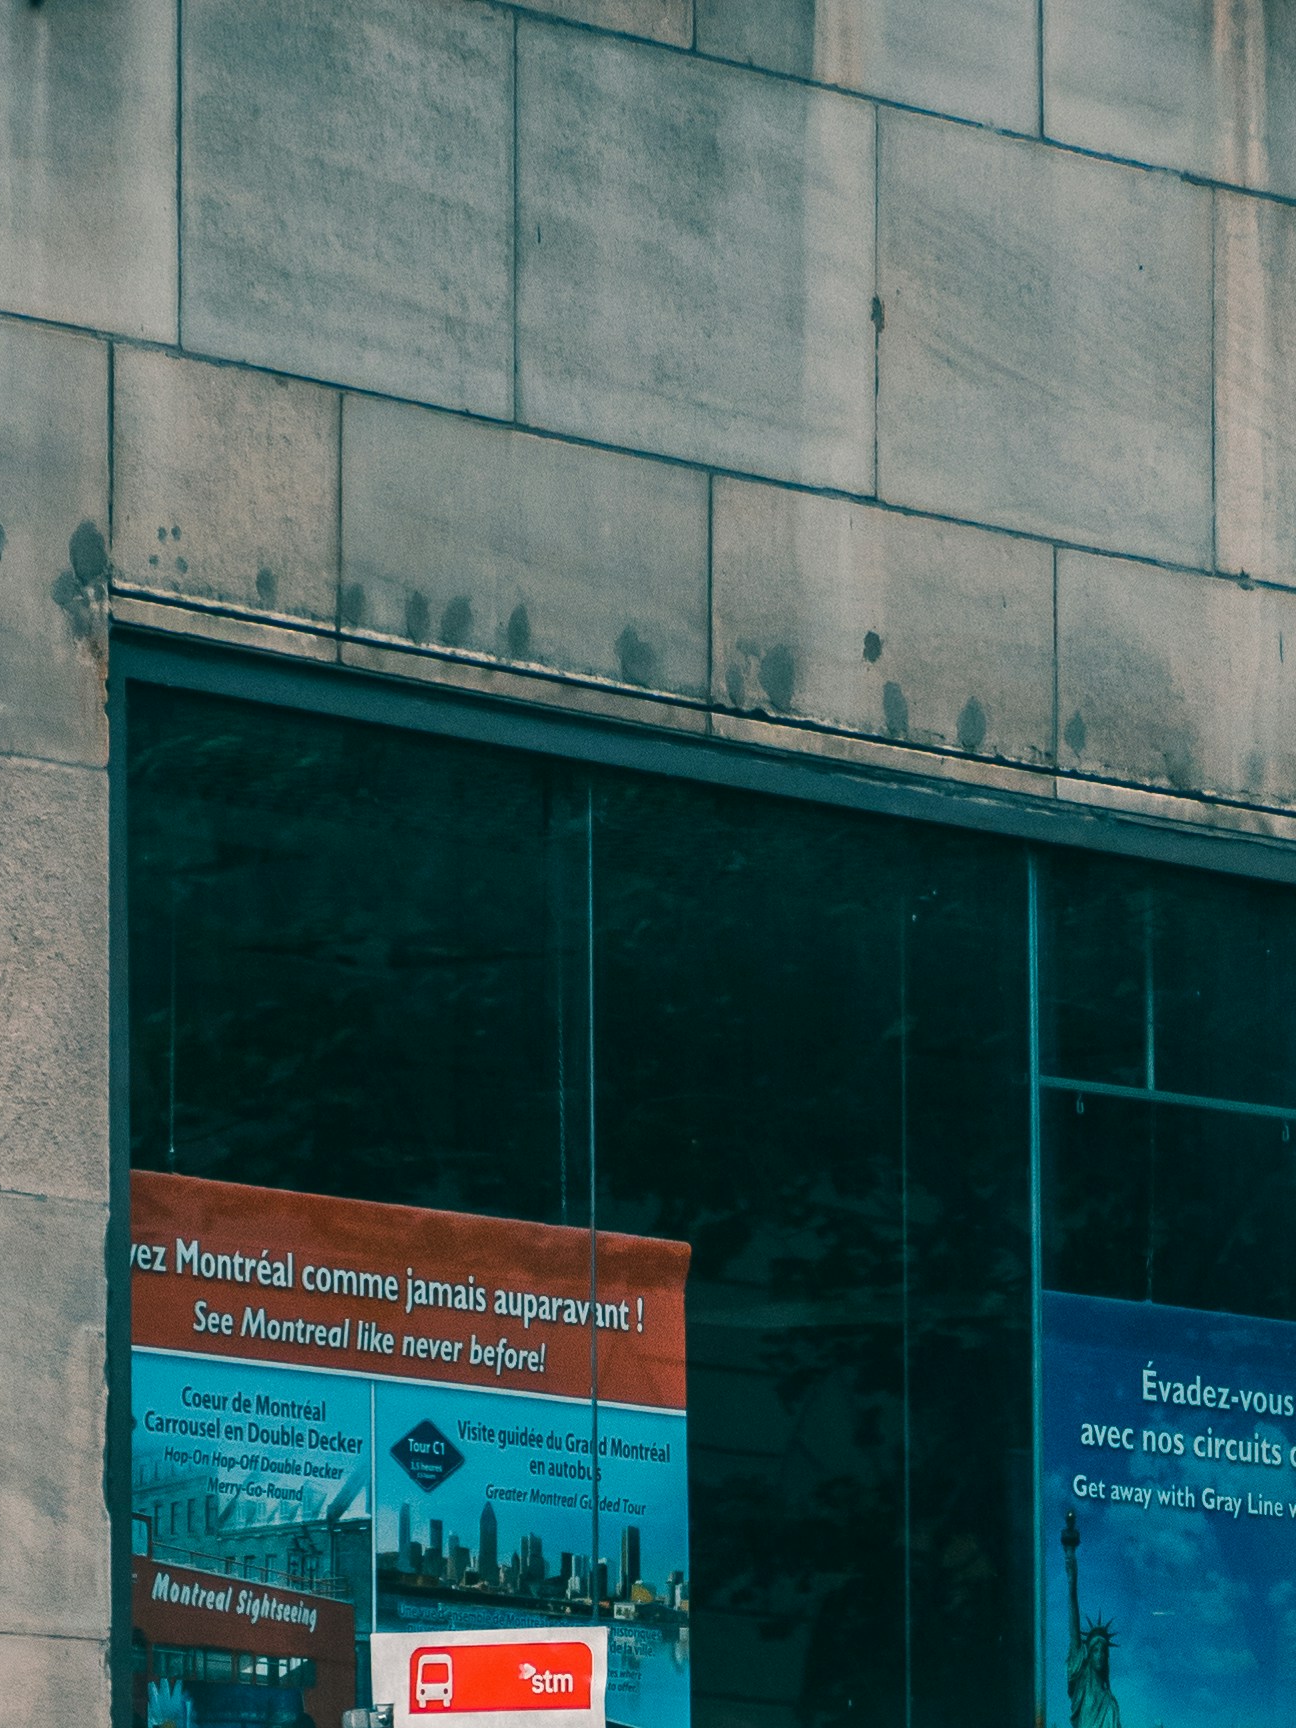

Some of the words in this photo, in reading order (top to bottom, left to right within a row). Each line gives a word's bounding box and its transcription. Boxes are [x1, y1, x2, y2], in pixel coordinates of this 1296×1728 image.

[175, 1238, 294, 1288] Montréal
[301, 1264, 399, 1301] comme
[406, 1267, 487, 1314] jamais
[494, 1289, 630, 1331] auparavant
[192, 1300, 234, 1335] See
[241, 1306, 350, 1349] Montreal
[357, 1320, 395, 1355] like
[402, 1334, 463, 1362] never
[469, 1333, 546, 1376] before!
[181, 1386, 229, 1411] Coeur
[231, 1391, 252, 1414] de
[256, 1394, 326, 1422] Montréal
[1142, 1360, 1294, 1417] Évadez-vous
[144, 1410, 220, 1439] Carrousel
[224, 1424, 244, 1442] en
[247, 1422, 304, 1449] Double
[308, 1429, 364, 1455] Decker
[408, 1438, 431, 1454] Tour
[433, 1441, 445, 1456] C1
[457, 1419, 495, 1443] Visite
[498, 1424, 544, 1451] guidée
[546, 1432, 563, 1450] du
[565, 1433, 606, 1456] Grad
[610, 1438, 671, 1464] Montréal
[1080, 1422, 1135, 1450] avec
[1142, 1430, 1185, 1456] nos
[1193, 1427, 1283, 1467] circuits
[164, 1446, 209, 1467] Hop-On
[211, 1451, 259, 1473] Hop-Off
[260, 1457, 302, 1476] Double
[304, 1461, 344, 1480] Decker
[529, 1460, 545, 1476] en
[547, 1461, 602, 1482] autobus
[207, 1477, 304, 1502] Merry-Go-Round
[486, 1484, 528, 1502] Greater
[530, 1488, 577, 1509] Montreal
[579, 1492, 620, 1513] Guded
[622, 1499, 647, 1516] Tour
[1073, 1474, 1105, 1499] Get
[1110, 1482, 1153, 1510] away
[1157, 1484, 1196, 1508] with
[1201, 1487, 1242, 1519] Gray
[1247, 1492, 1284, 1518] Line
[151, 1571, 233, 1613] Montreal
[235, 1588, 318, 1634] Sightseeing
[531, 1669, 574, 1695] stm
